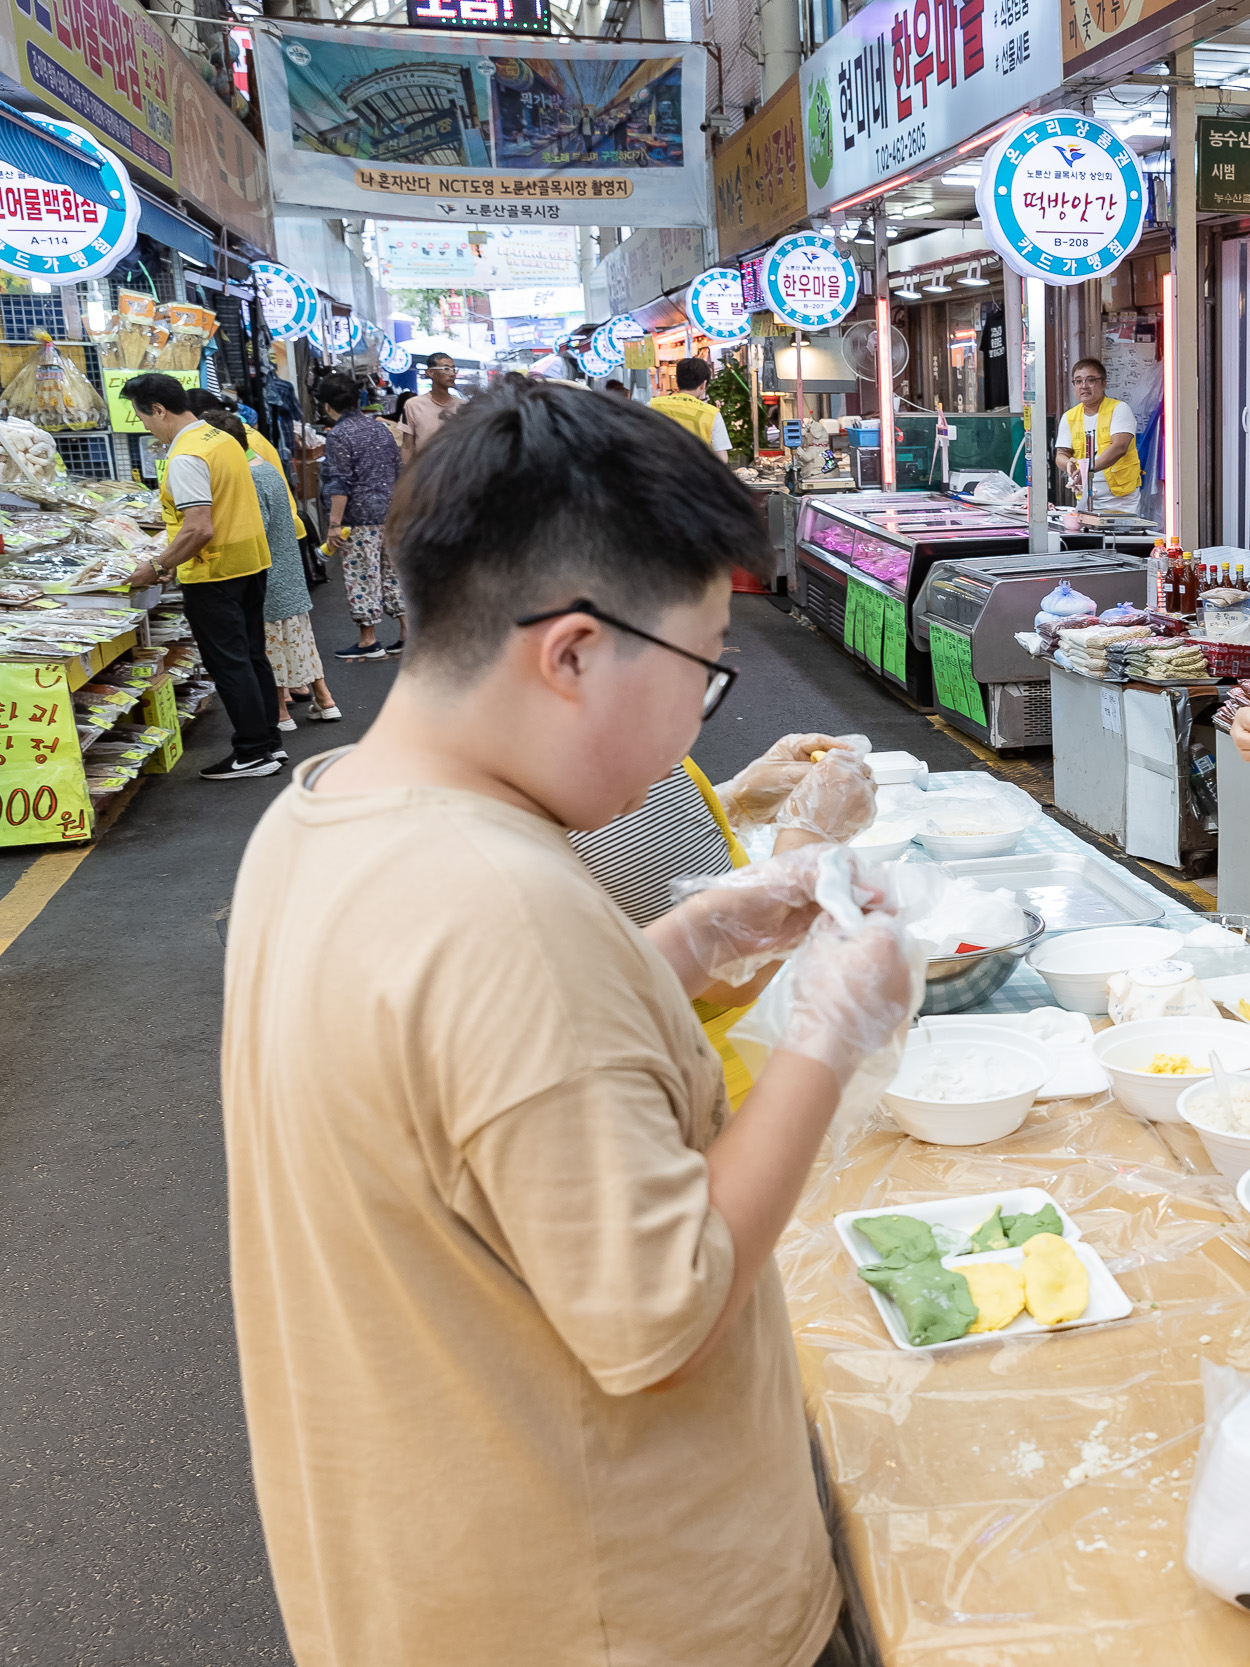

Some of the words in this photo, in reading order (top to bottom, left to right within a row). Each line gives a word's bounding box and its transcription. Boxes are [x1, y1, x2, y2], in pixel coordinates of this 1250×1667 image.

[1001, 30, 1031, 76] 선물세트
[838, 32, 889, 152] 현미네
[361, 171, 375, 187] 나
[378, 174, 431, 193] 혼자산다
[439, 178, 494, 195] NCT도영
[500, 179, 587, 197] 노룬산골목시장
[591, 180, 628, 197] 촬영지
[1054, 170, 1087, 180] 골목시장
[1089, 172, 1113, 181] 상인회
[1211, 163, 1236, 181] 시범
[466, 204, 560, 219] 노룬산골목시장
[1023, 191, 1118, 223] 떡방앗간
[30, 236, 68, 245] A-114
[1054, 238, 1089, 248] B-208
[1018, 237, 1125, 275] 카드가맹점
[783, 273, 840, 299] 한우마을
